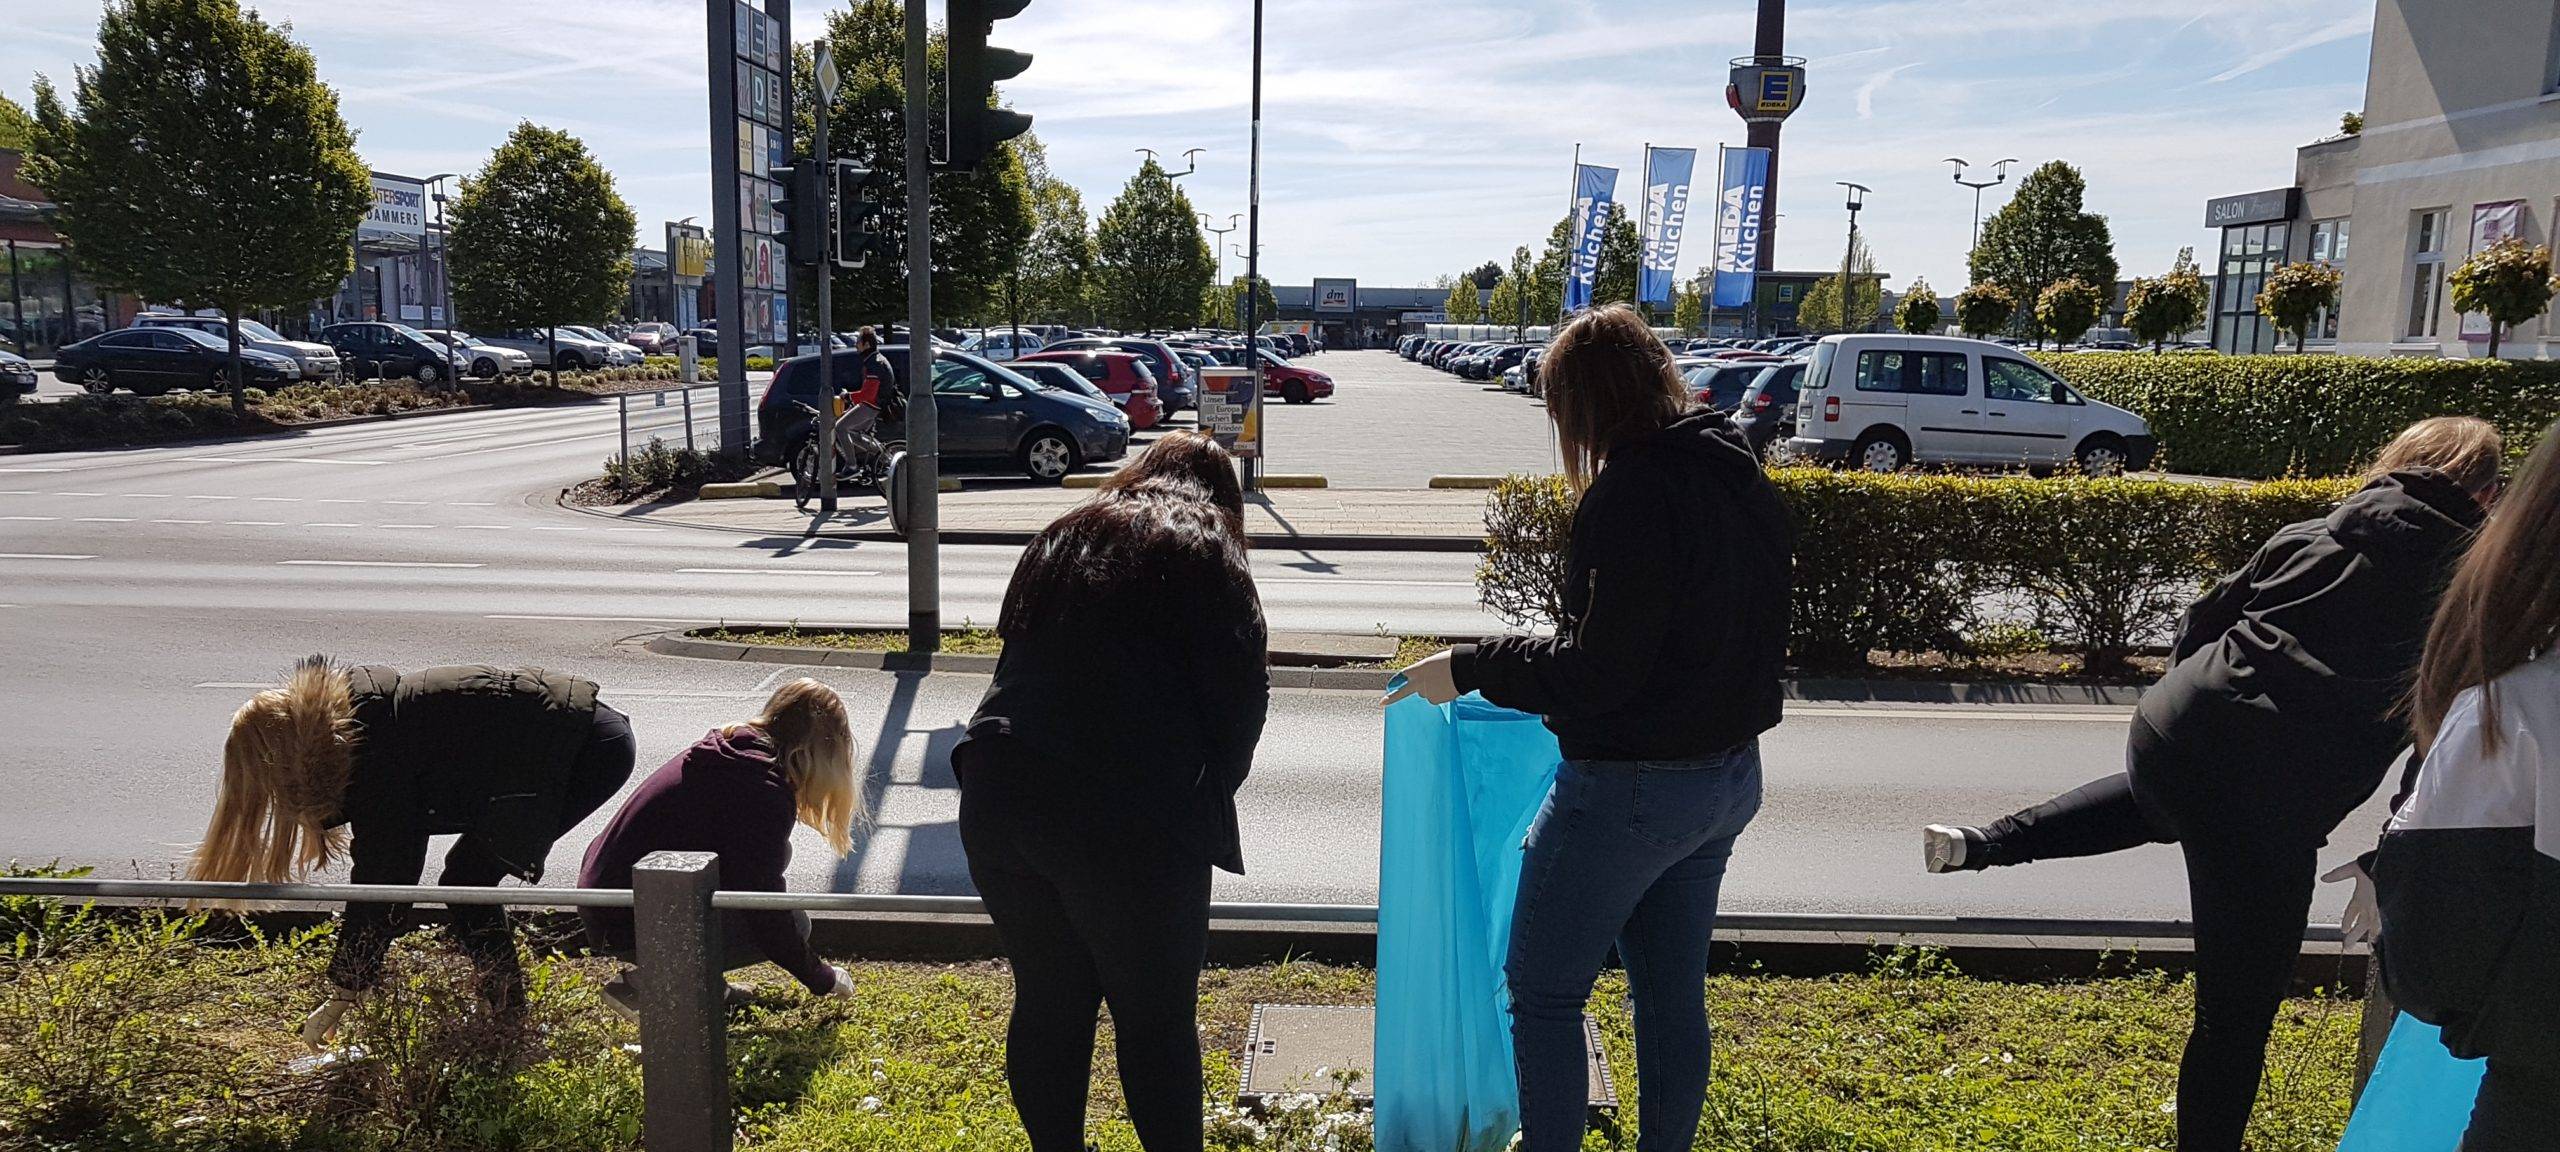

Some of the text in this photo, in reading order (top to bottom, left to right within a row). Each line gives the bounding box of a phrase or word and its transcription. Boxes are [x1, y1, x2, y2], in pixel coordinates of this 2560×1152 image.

[1763, 75, 1788, 100] E
[372, 187, 421, 207] NTERSPORT
[366, 208, 418, 226] DAMMERS
[2215, 201, 2245, 220] SALON
[1657, 184, 1688, 271] Küchen
[1718, 185, 1745, 273] MEDA
[1735, 185, 1764, 273] Küchen
[1580, 201, 1610, 285] Küchen
[1326, 289, 1344, 300] dm
